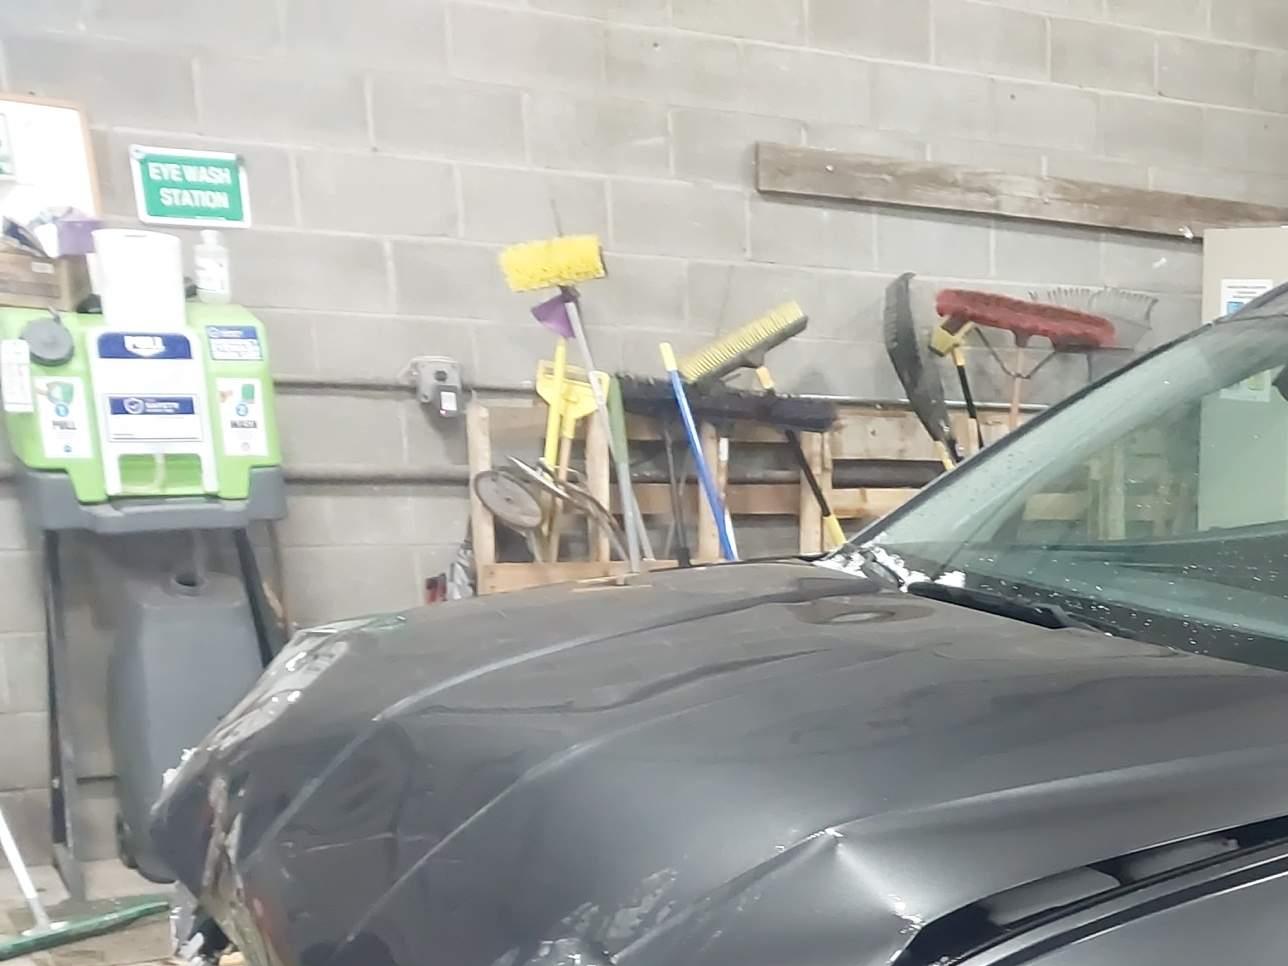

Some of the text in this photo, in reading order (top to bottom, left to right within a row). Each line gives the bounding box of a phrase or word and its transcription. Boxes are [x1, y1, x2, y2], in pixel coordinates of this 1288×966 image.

[148, 162, 231, 185] EYE WASH
[159, 187, 230, 209] STATION
